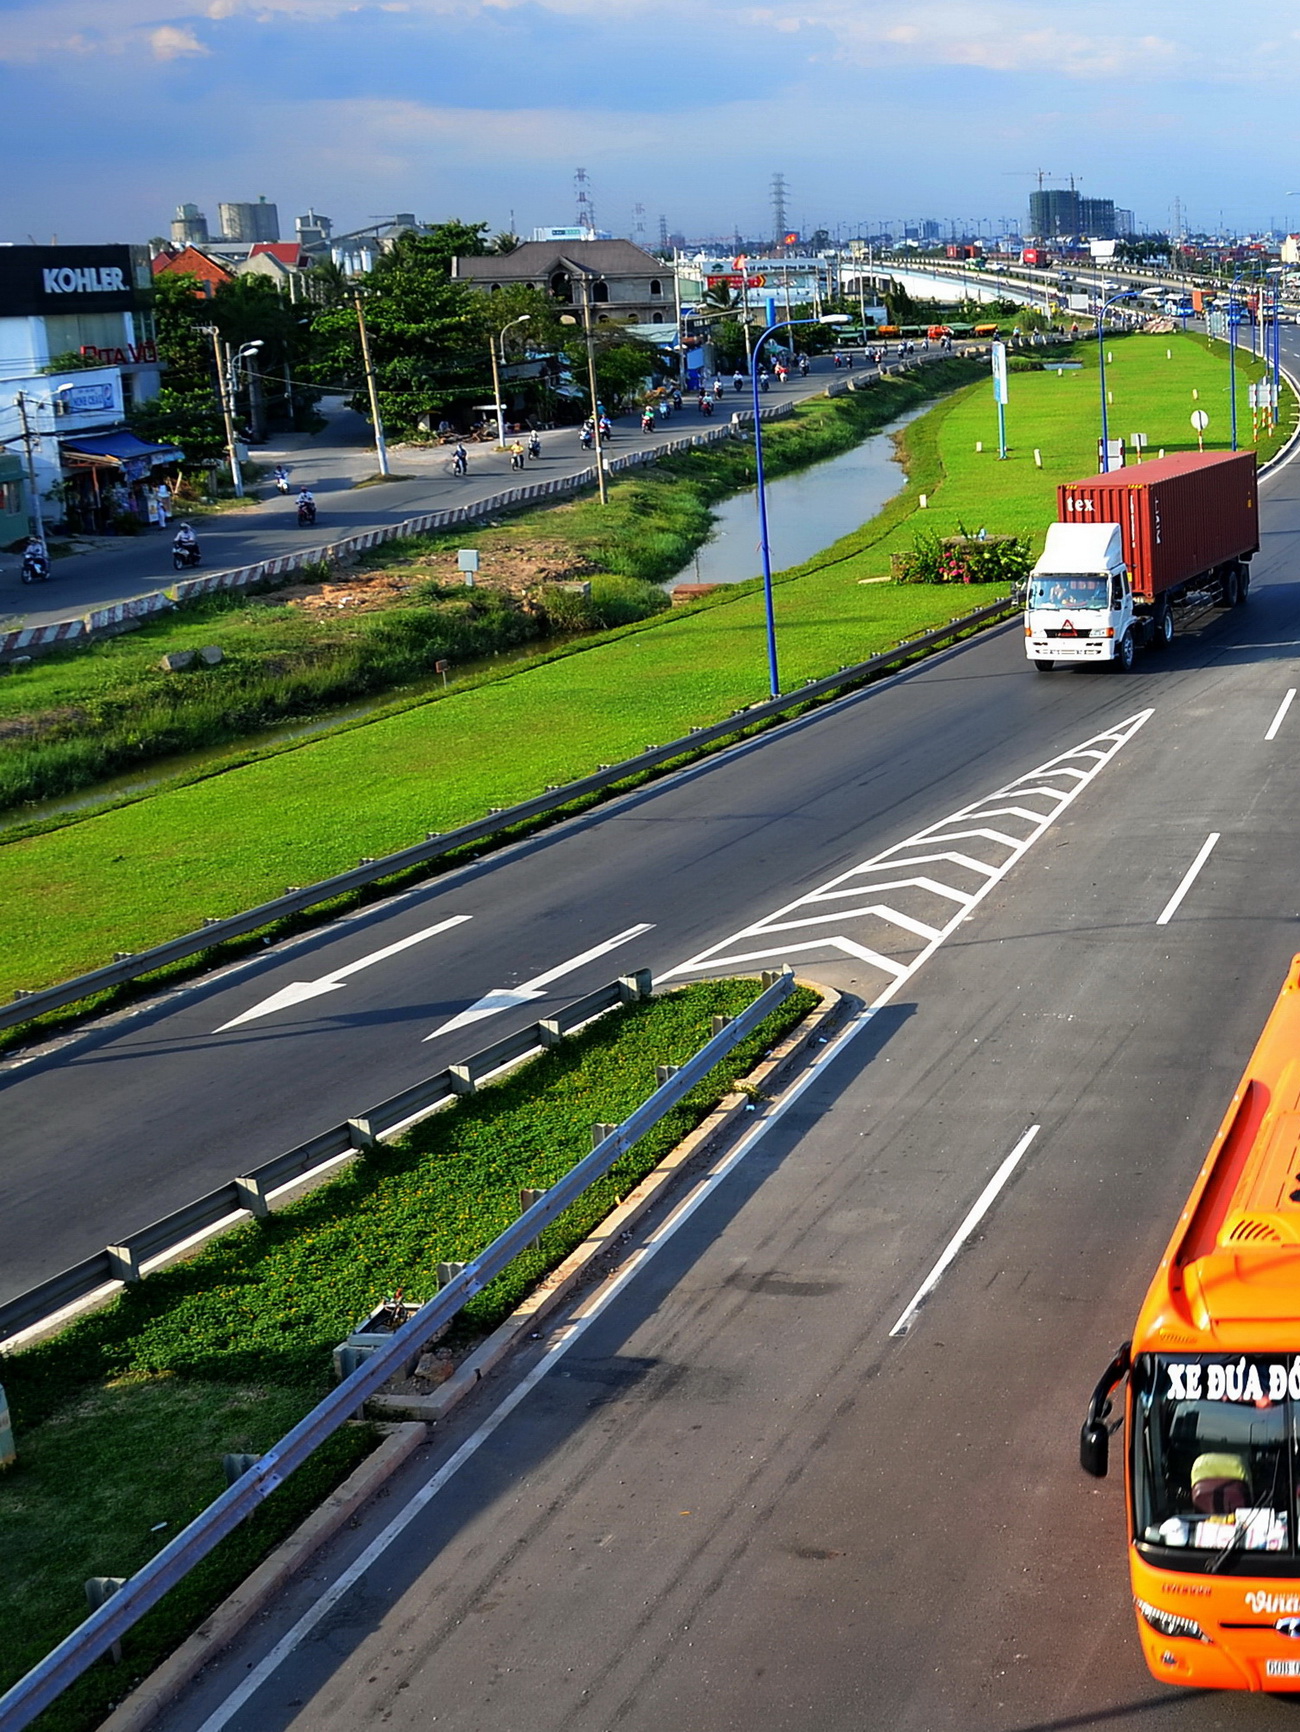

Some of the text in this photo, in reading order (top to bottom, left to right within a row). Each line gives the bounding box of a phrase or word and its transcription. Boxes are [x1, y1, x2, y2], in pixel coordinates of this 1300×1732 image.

[1066, 496, 1095, 512] tex
[1167, 1363, 1202, 1400] XE
[1207, 1355, 1264, 1401] ĐƯA
